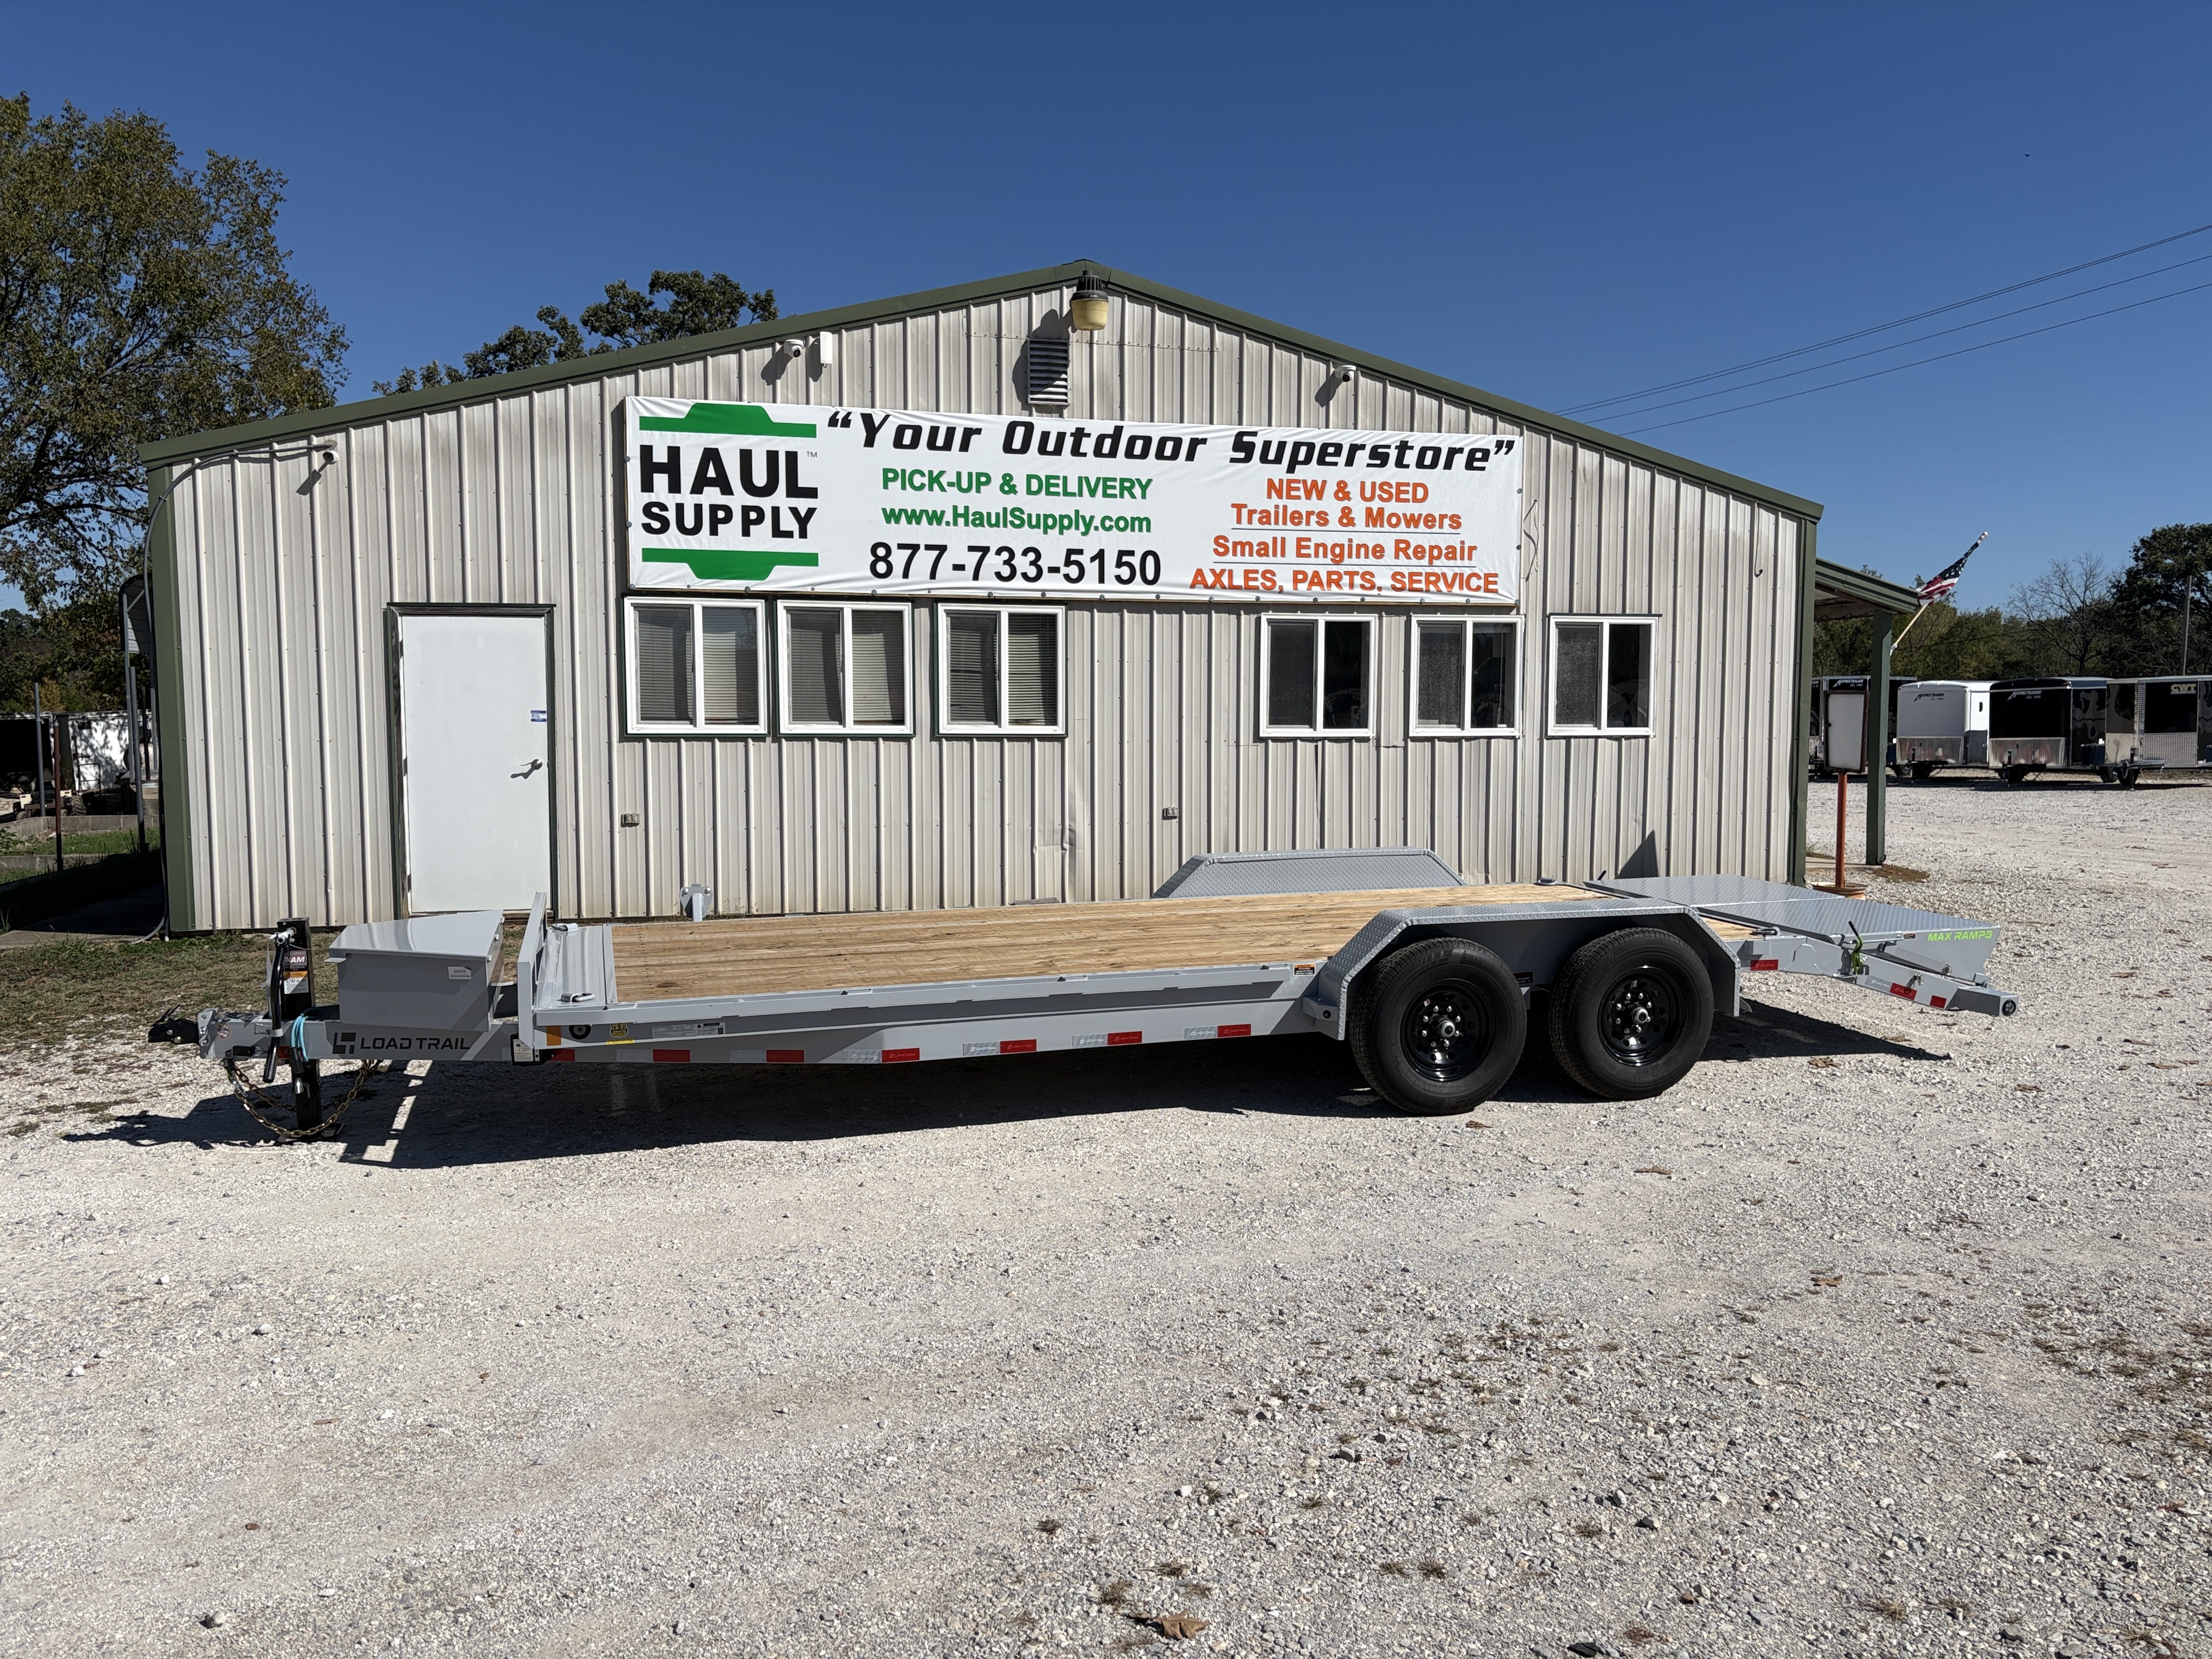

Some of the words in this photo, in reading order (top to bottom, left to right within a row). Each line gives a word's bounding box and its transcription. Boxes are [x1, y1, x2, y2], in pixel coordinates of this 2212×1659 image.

[827, 410, 982, 453] “Your
[1002, 420, 1207, 462] Outdoor
[1229, 431, 1514, 473] Superstore”
[640, 444, 818, 499] HAUL
[882, 468, 991, 493] PICK-UP
[999, 473, 1018, 495] &
[1026, 474, 1153, 499] DELIVERY
[1267, 478, 1327, 500] NEW
[1334, 480, 1351, 501] &
[1359, 481, 1429, 503] USED
[641, 501, 817, 539] SUPPLY
[882, 505, 1151, 536] www.HaulSupply.com
[1231, 503, 1329, 527] Trailers
[1338, 506, 1356, 528] &
[1365, 507, 1462, 530] Mowers
[870, 541, 1161, 586] 877-733-5150
[1213, 535, 1285, 558] Small
[1296, 537, 1385, 566] Engine
[1394, 539, 1477, 562] Repair
[1189, 568, 1283, 593] AXLES,
[1293, 570, 1382, 595] PARTS,
[1391, 571, 1498, 593] SERVICE
[1927, 932, 1952, 941] MAX
[1954, 930, 1993, 940] RAMPS
[360, 1037, 413, 1049] LOAD
[415, 1037, 470, 1049] TRAIL
